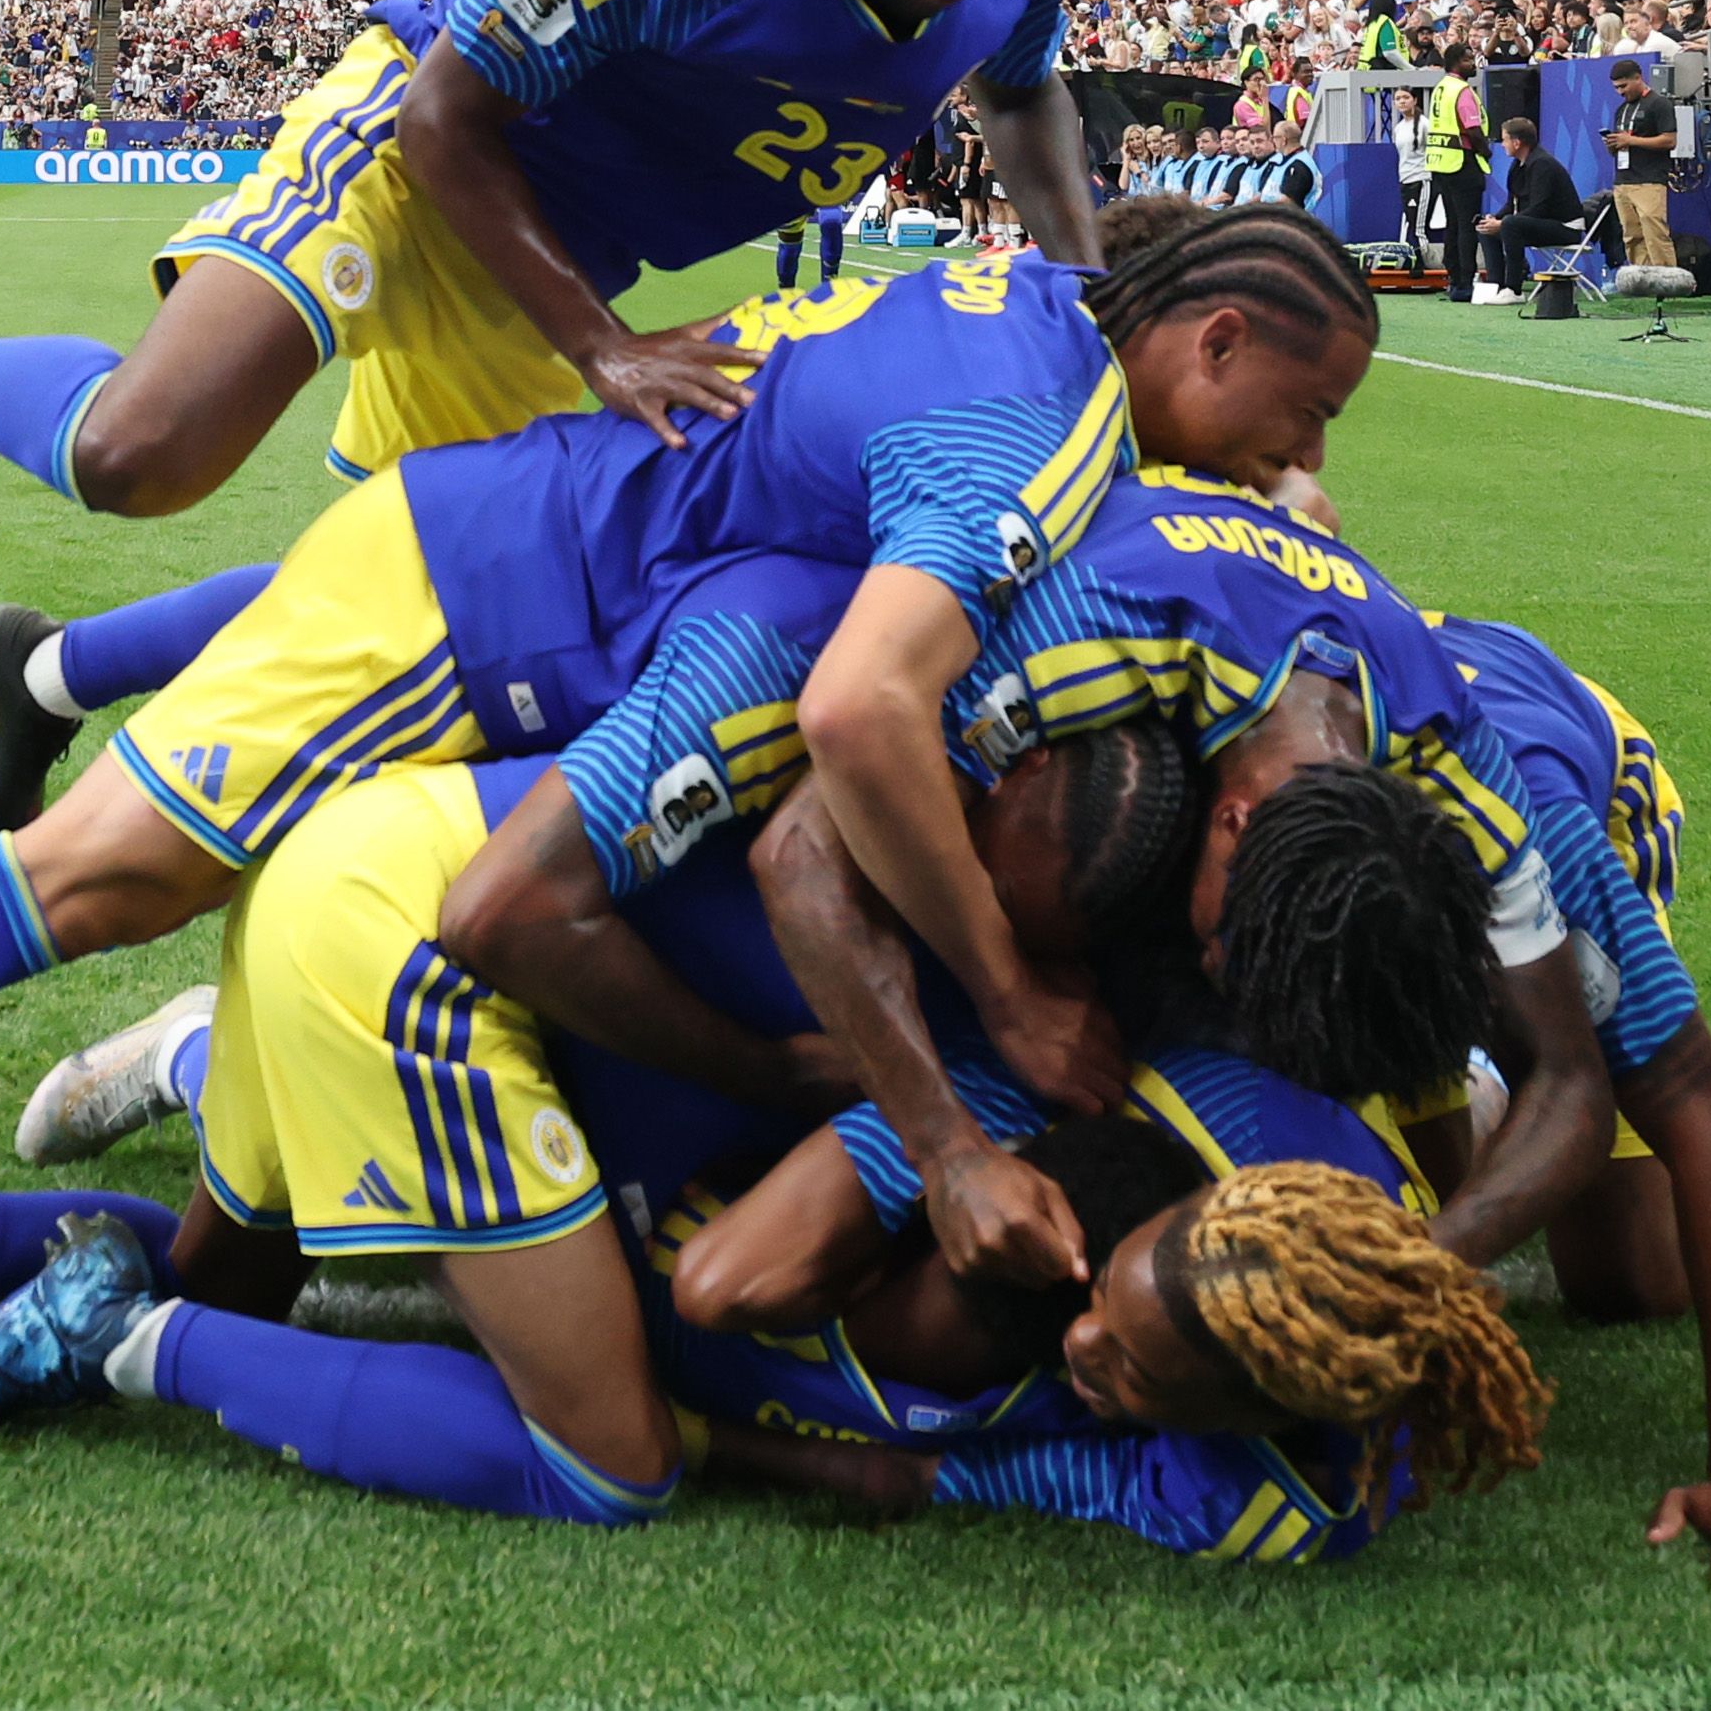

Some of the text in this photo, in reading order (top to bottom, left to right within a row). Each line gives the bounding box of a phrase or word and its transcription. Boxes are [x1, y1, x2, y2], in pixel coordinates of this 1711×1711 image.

[35, 151, 224, 184] aramco
[733, 102, 887, 206] 23
[1151, 514, 1369, 601] BACUNA
